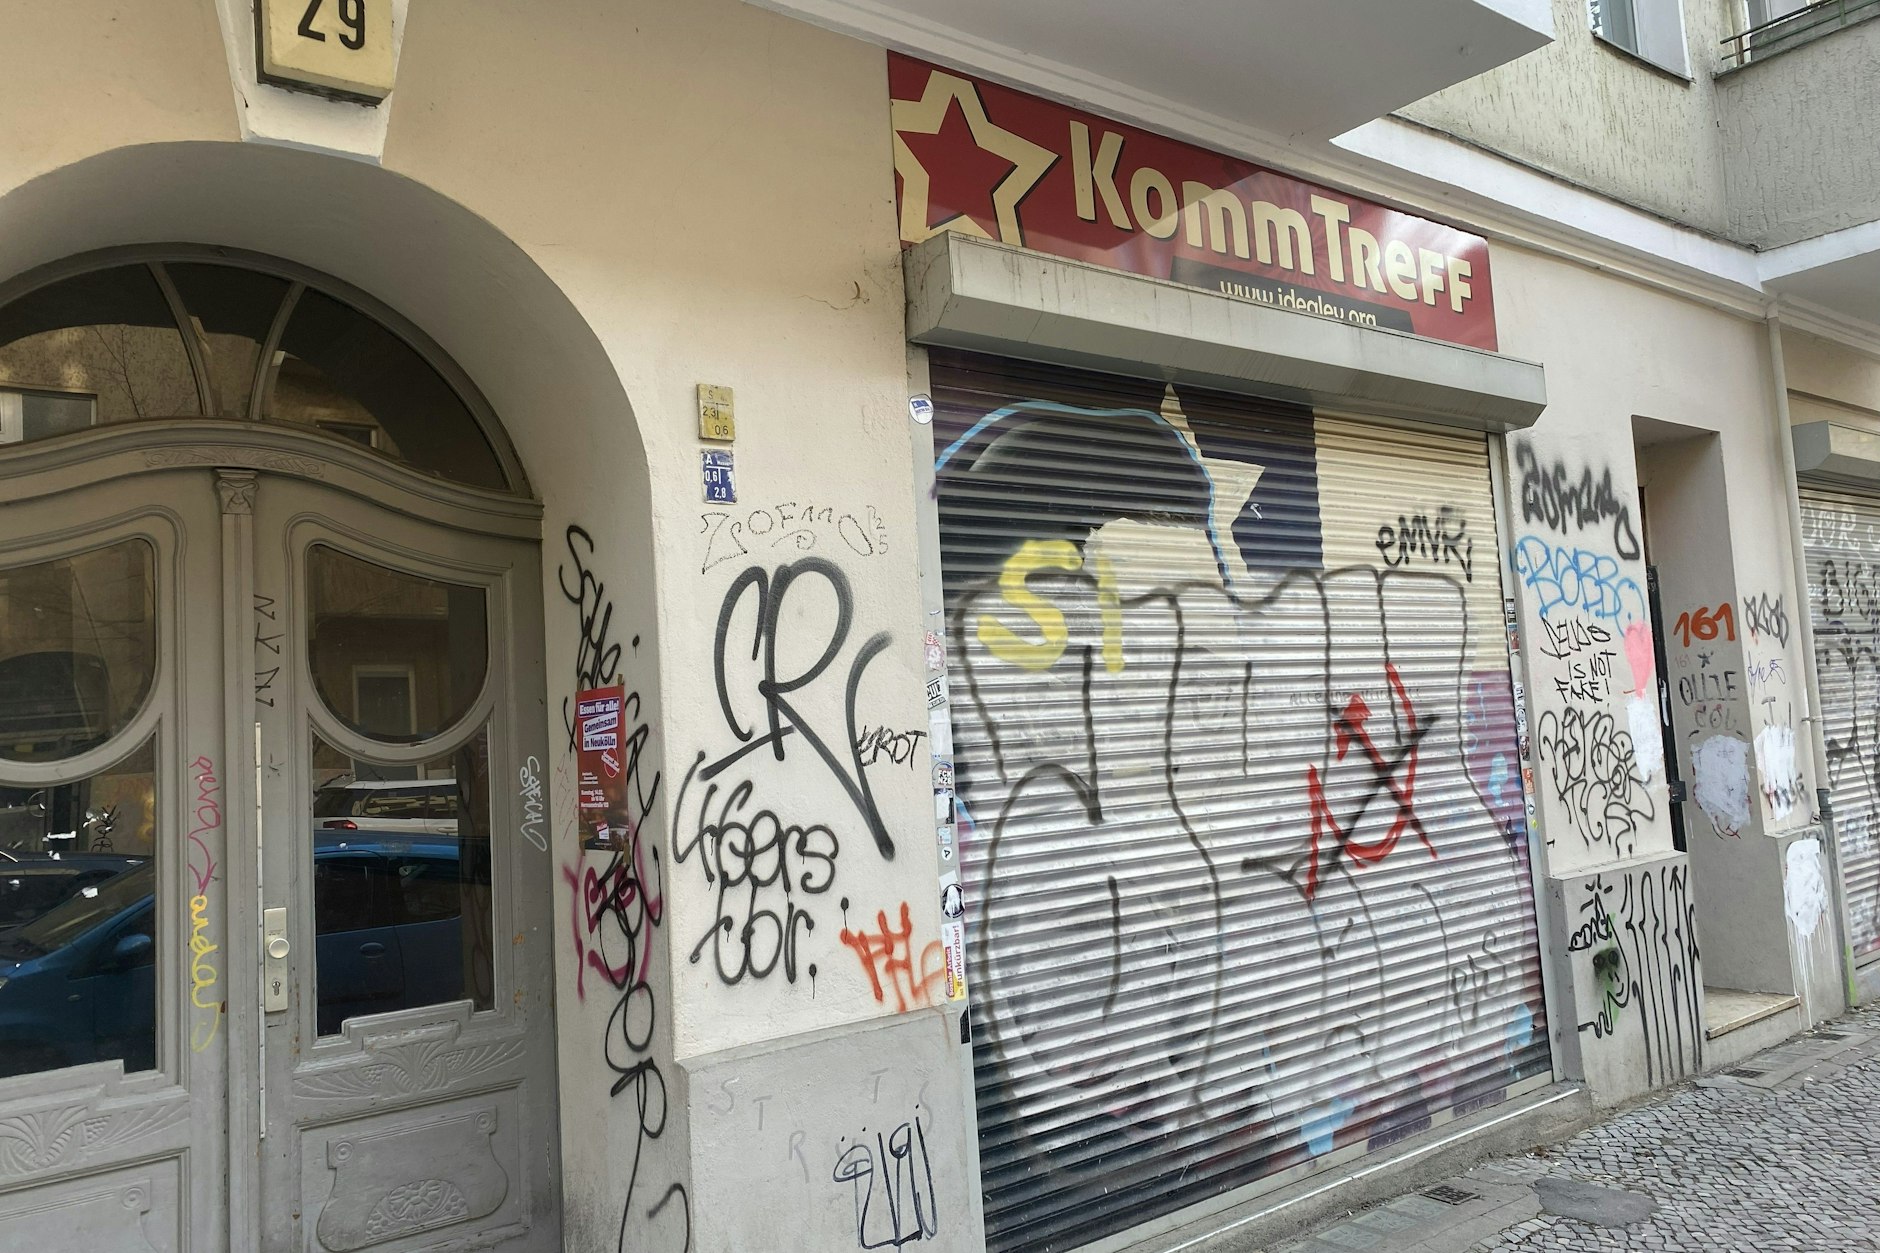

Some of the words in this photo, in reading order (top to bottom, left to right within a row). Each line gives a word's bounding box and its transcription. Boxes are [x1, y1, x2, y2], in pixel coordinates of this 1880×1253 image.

[298, 0, 366, 51] 29
[702, 405, 717, 419] 2,3
[714, 424, 729, 438] 0,6
[706, 453, 713, 465] A
[704, 470, 718, 484] 0,6
[713, 486, 727, 500] 2,8
[1673, 602, 1736, 648] 161
[1567, 660, 1587, 681] IS
[1589, 649, 1617, 681] NOT
[579, 704, 596, 715] Essen
[595, 701, 605, 713] für
[605, 699, 620, 711] alle!
[584, 717, 617, 733] Gemeinsam
[584, 738, 590, 748] in
[590, 735, 616, 748] Neukölln
[945, 947, 953, 971] Arbeit
[953, 924, 964, 988] #unkürzbar!
